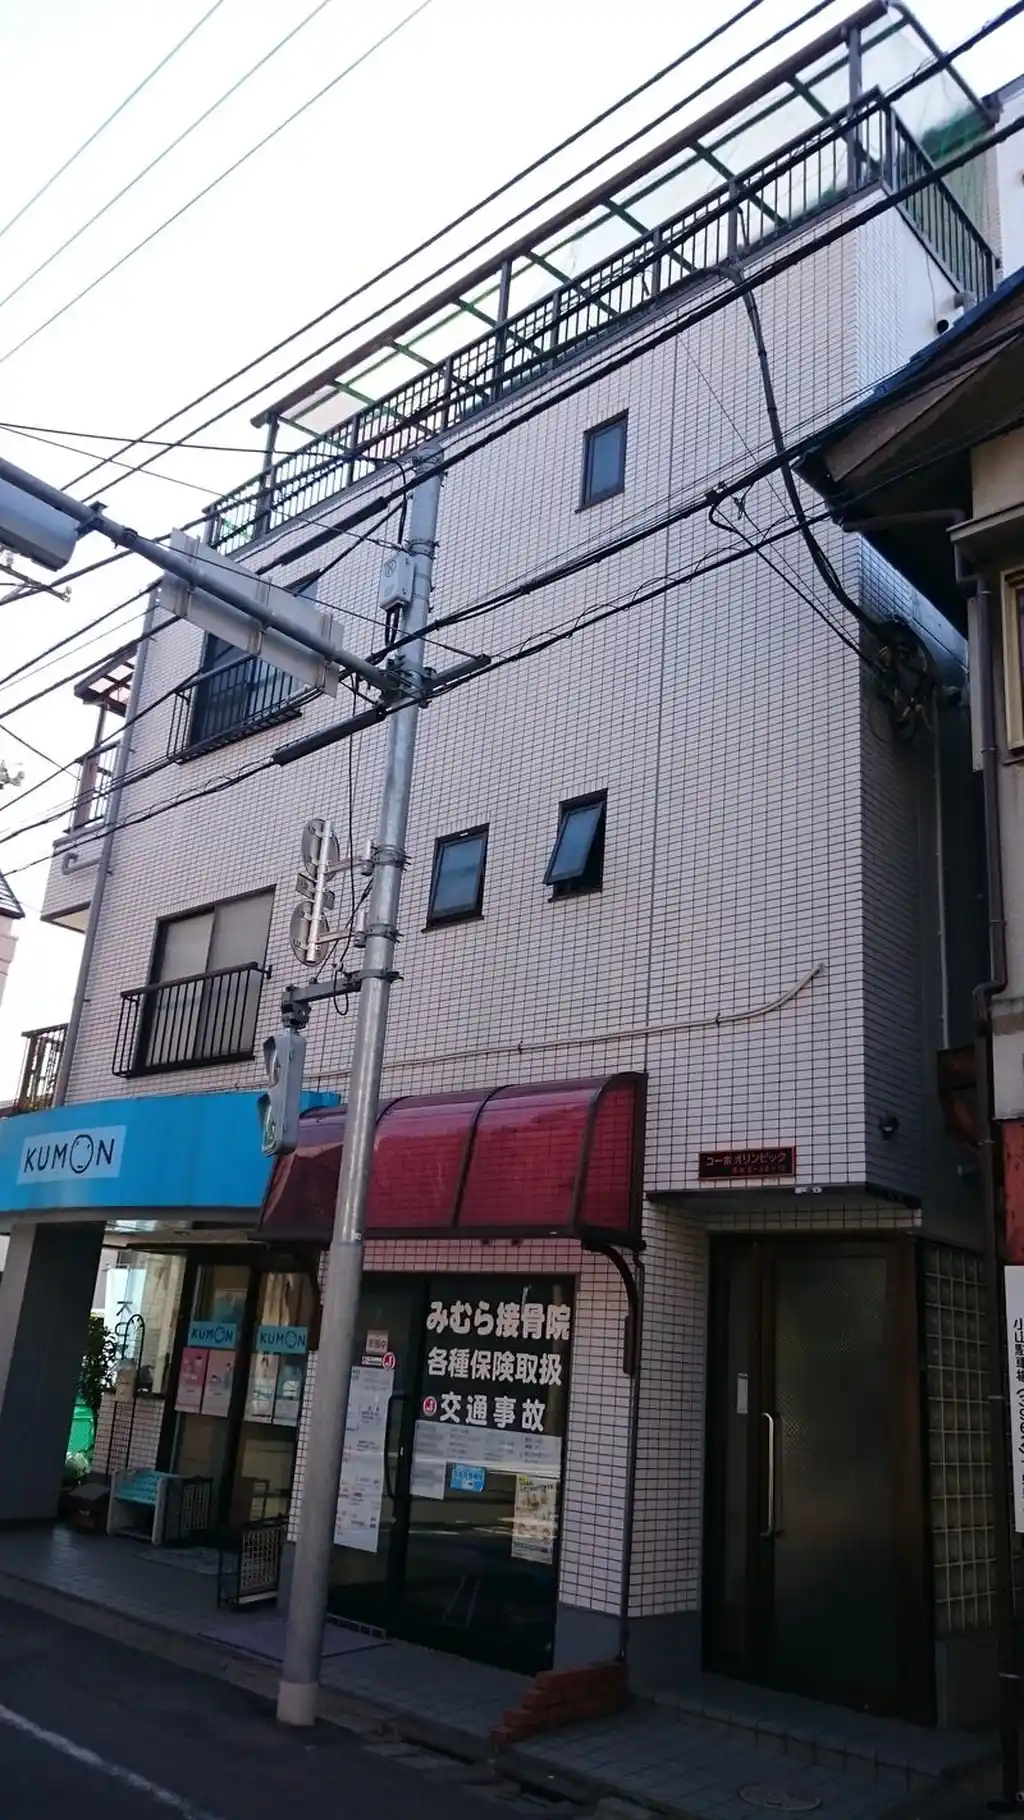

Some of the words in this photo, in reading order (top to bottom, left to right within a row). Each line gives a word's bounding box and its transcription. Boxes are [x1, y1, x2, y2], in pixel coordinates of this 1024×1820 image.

[23, 1134, 115, 1174] KUMON
[190, 1326, 234, 1344] KUMON
[259, 1329, 307, 1348] KUMON
[425, 1299, 571, 1341] みむら接骨院
[426, 1346, 563, 1386] 各種保険取扱
[439, 1390, 547, 1433] 交通事故
